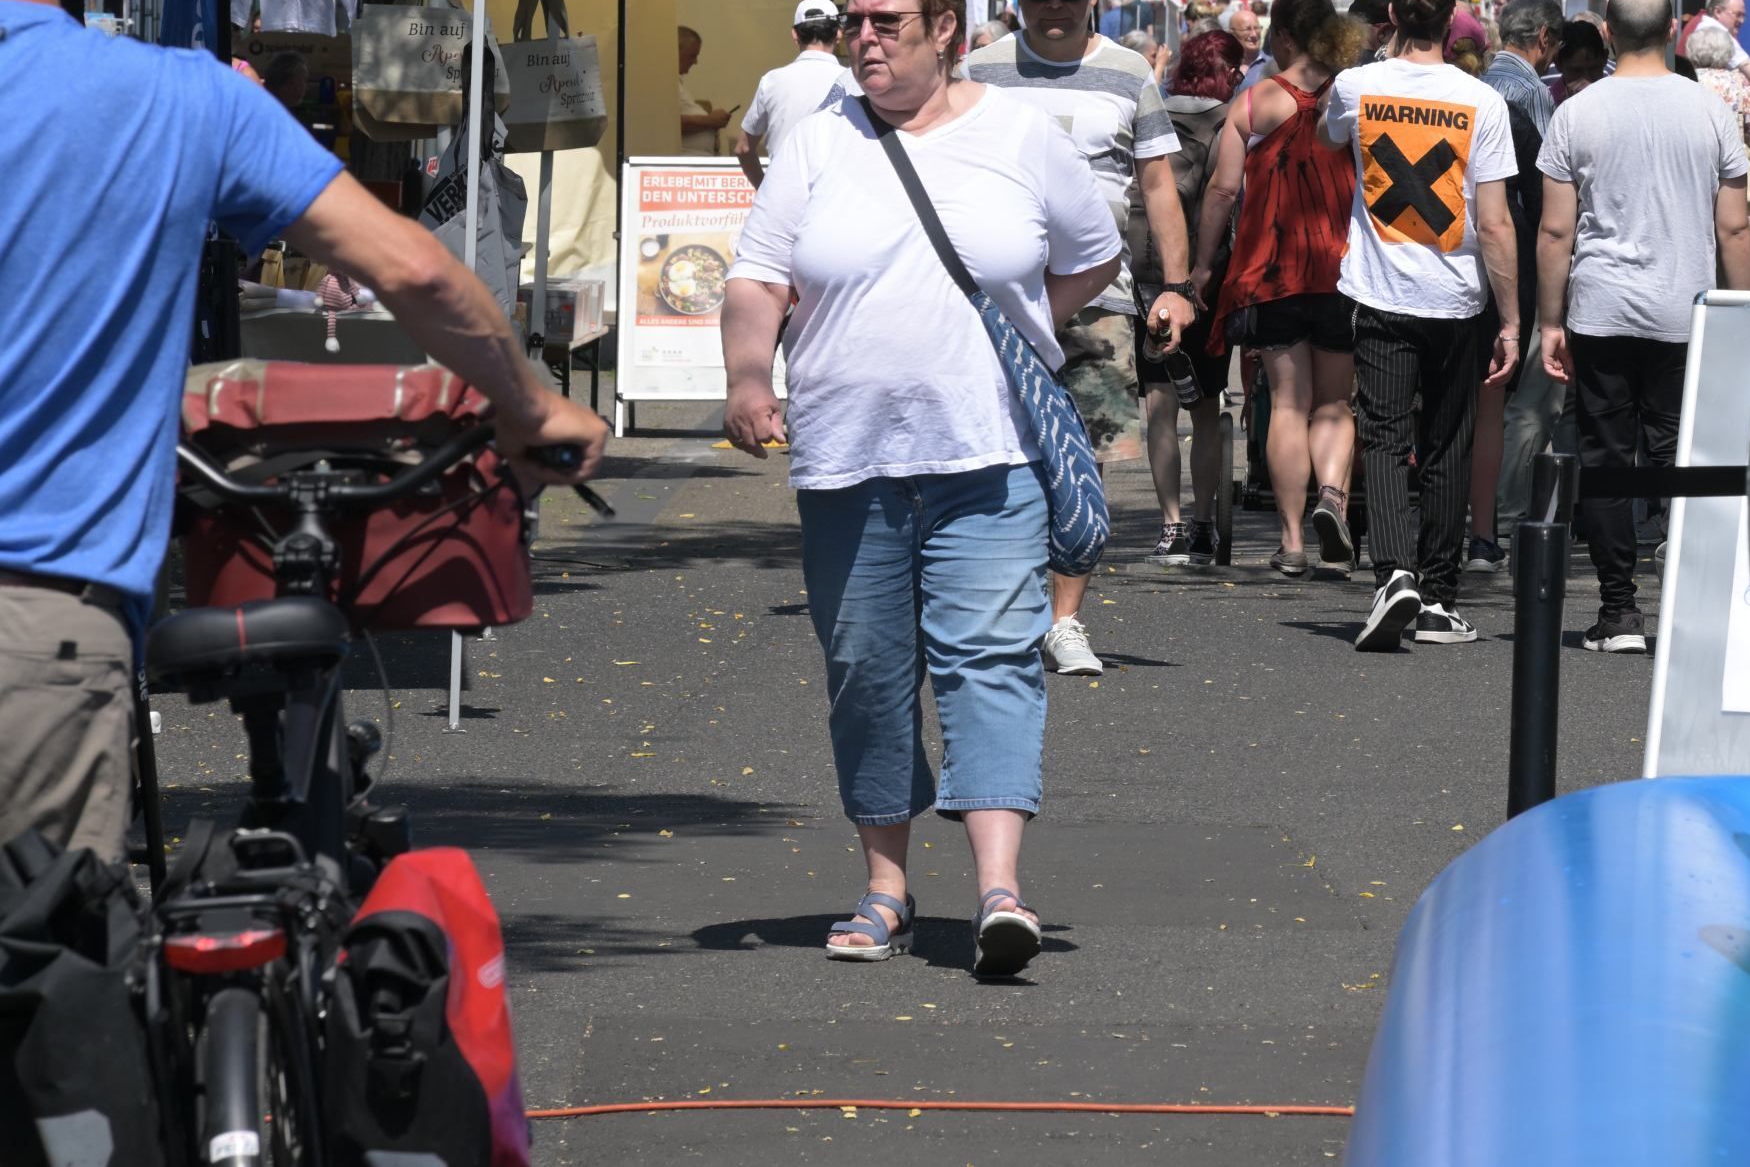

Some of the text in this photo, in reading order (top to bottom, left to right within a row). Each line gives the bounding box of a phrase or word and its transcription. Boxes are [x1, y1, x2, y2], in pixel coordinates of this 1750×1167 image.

[408, 22, 465, 39] Bin auf
[527, 54, 549, 66] Bin
[1365, 103, 1469, 130] WARNING
[643, 176, 692, 187] ERLEBE
[694, 177, 718, 188] MIT
[642, 191, 673, 203] DEN
